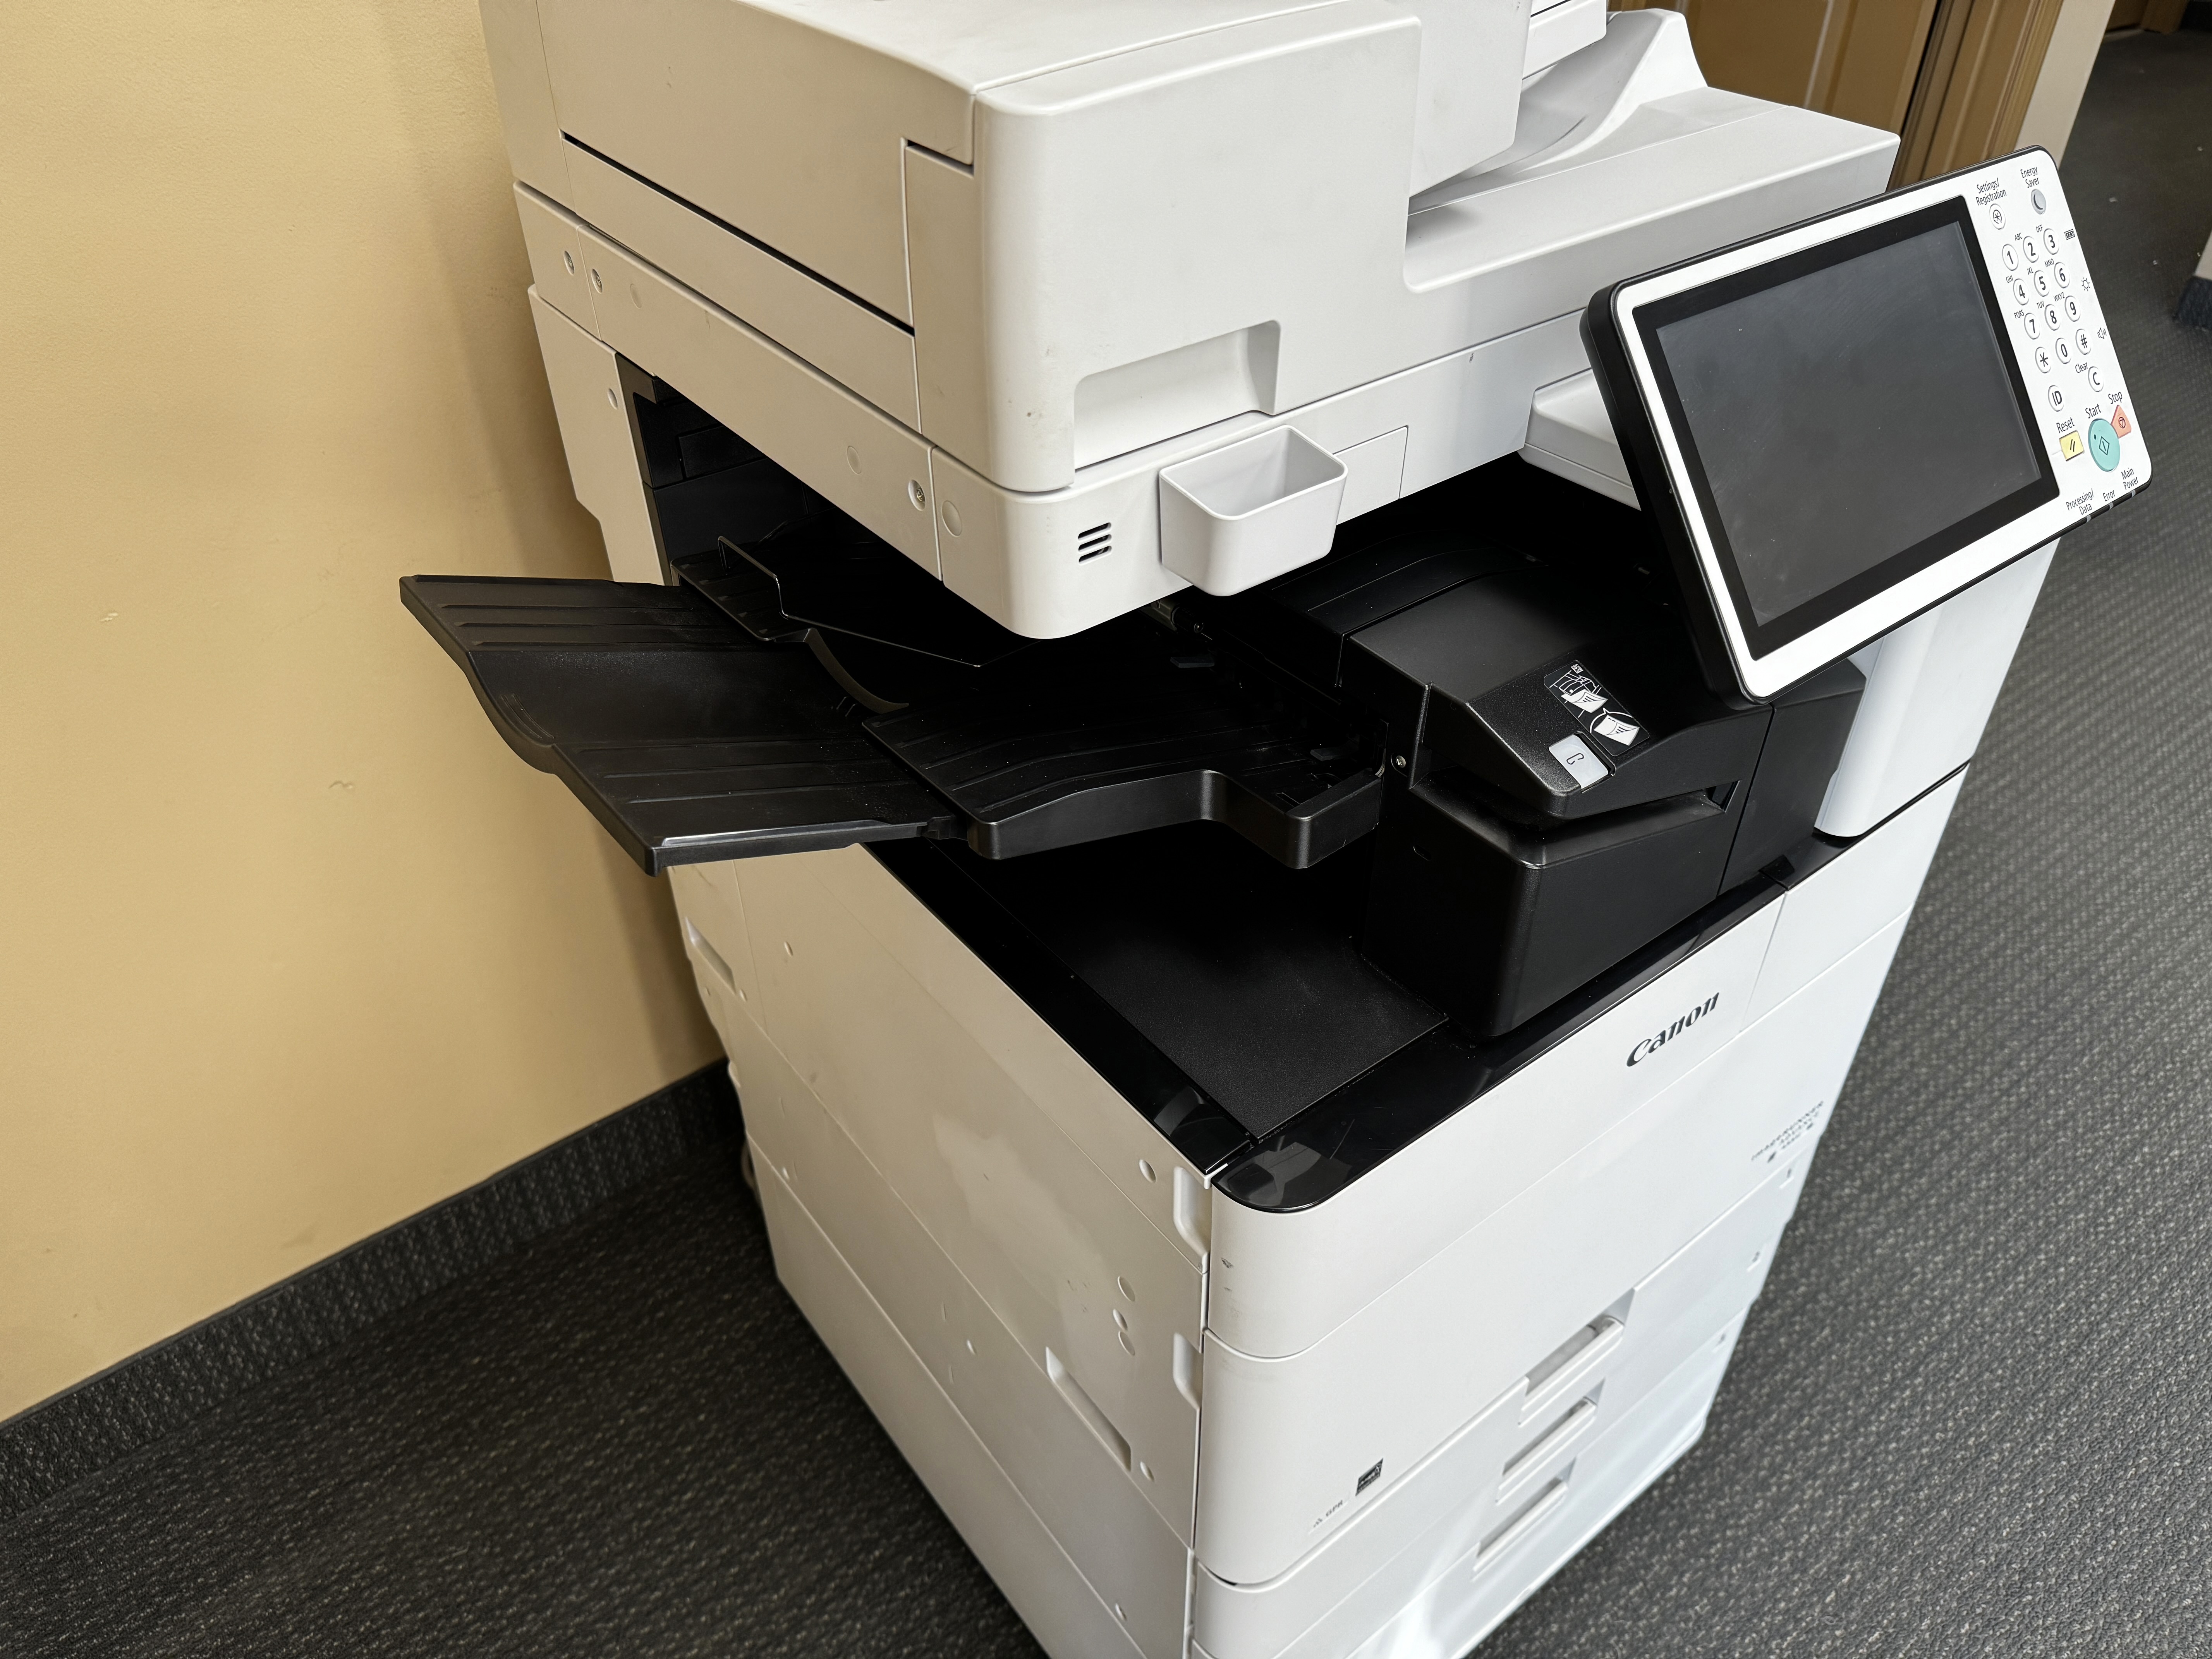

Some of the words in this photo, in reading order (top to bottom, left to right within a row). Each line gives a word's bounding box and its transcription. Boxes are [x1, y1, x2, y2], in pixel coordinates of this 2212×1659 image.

[2021, 167, 2038, 178] Energy
[1977, 178, 1999, 194] Settings/
[2025, 177, 2040, 188] Saver
[1976, 189, 2007, 206] Registration
[2014, 233, 2023, 241] ABC
[2048, 234, 2056, 248] 3
[2028, 242, 2036, 256] 2
[2007, 251, 2014, 264] 1
[2045, 258, 2054, 267] MNO
[2059, 268, 2066, 282] 6
[2039, 276, 2046, 290] 5
[2019, 285, 2025, 298] 4
[2054, 292, 2065, 302] WXYZ
[2014, 310, 2024, 319] PQRS
[2070, 301, 2076, 315] 9
[2050, 310, 2057, 324] 8
[2029, 319, 2035, 333] 7
[2081, 334, 2088, 349] #
[2061, 344, 2068, 357] 0
[2075, 362, 2088, 374] Clear
[2093, 372, 2100, 386] C
[2052, 390, 2063, 406] ID
[2108, 392, 2123, 404] Stop
[2085, 404, 2102, 419] Start
[2056, 417, 2075, 433] Reset
[2121, 468, 2134, 480] Main
[2123, 477, 2139, 490] Power
[2066, 488, 2094, 511] Processing/
[2103, 490, 2116, 502] Error
[2079, 503, 2092, 515] Data
[1626, 992, 1719, 1067] Canon
